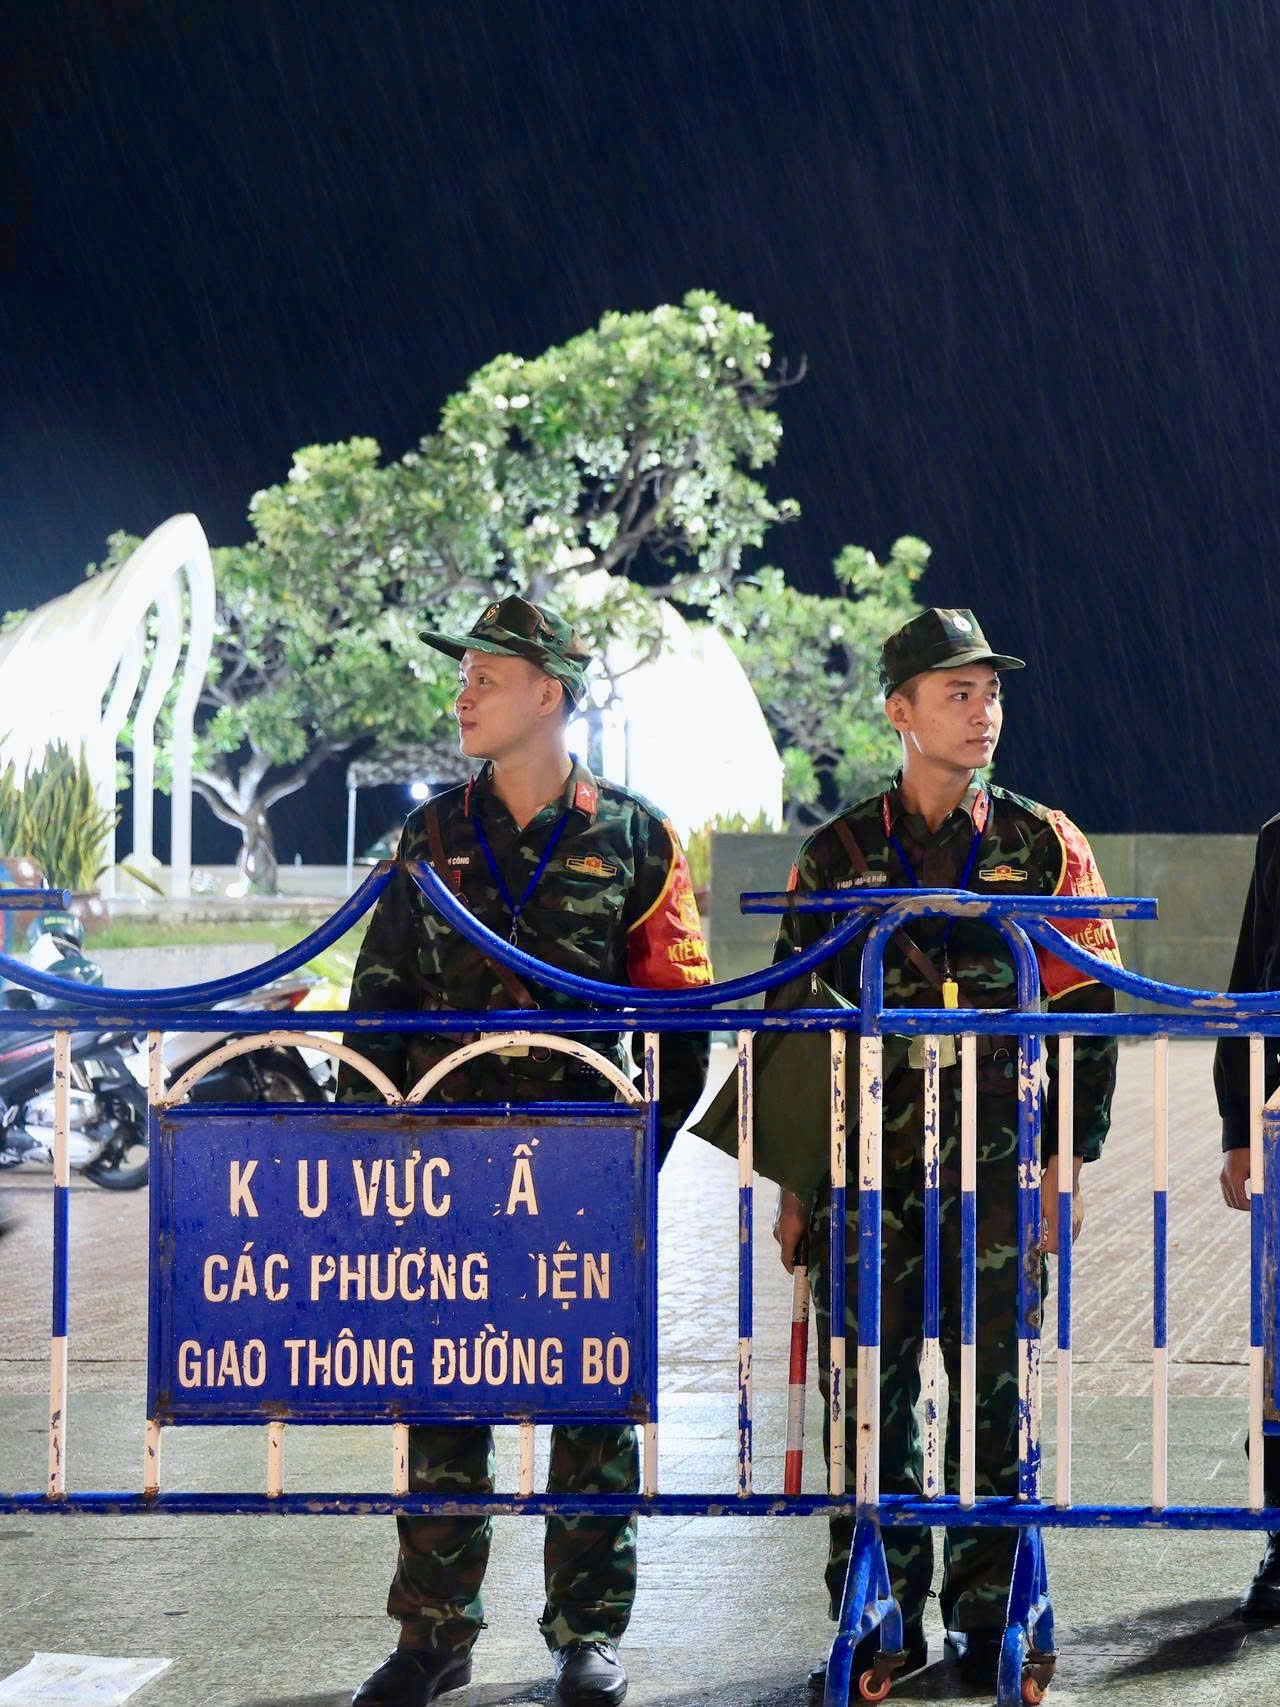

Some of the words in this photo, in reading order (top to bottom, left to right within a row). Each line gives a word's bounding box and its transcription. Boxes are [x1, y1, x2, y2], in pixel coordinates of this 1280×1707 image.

[229, 1158, 328, 1218] KU
[352, 1150, 451, 1227] VỰC
[203, 1242, 289, 1303] CÁC
[520, 1241, 610, 1310] IỆN
[178, 1339, 267, 1388] GIAO
[284, 1327, 414, 1387] THÔNG
[431, 1323, 563, 1386] ĐƯỜNG
